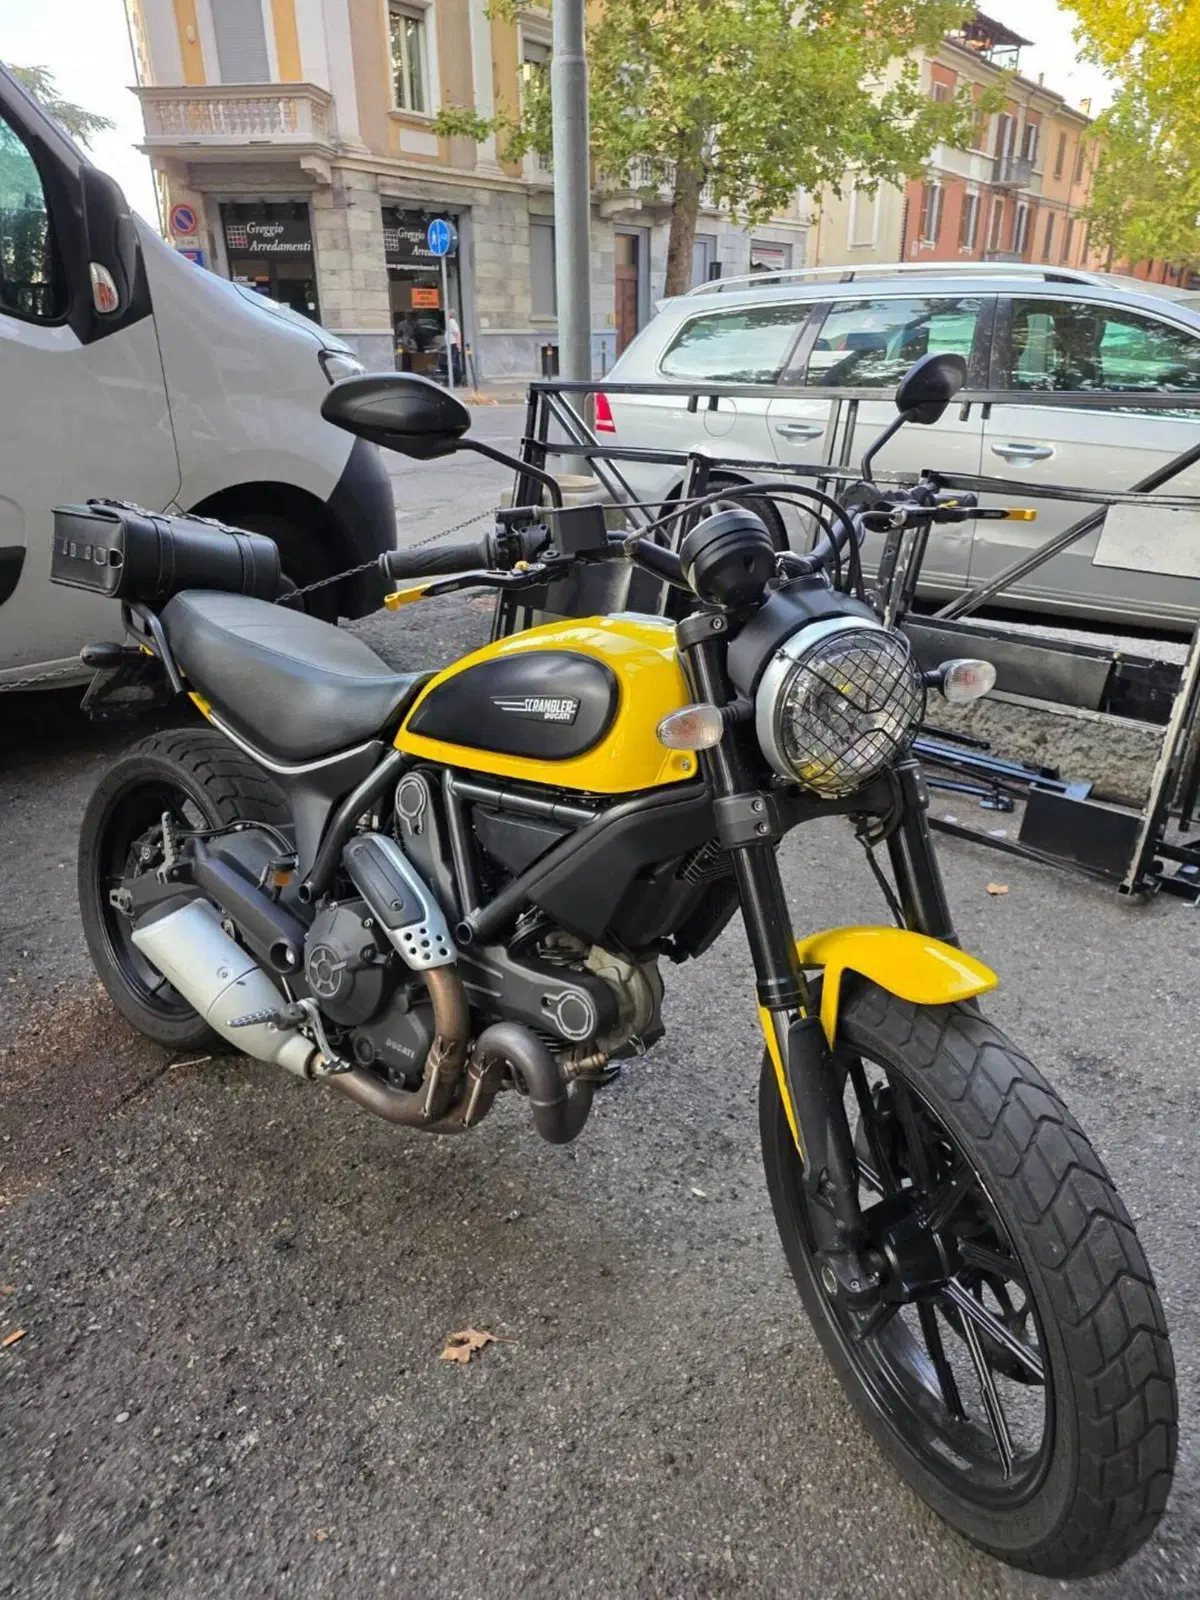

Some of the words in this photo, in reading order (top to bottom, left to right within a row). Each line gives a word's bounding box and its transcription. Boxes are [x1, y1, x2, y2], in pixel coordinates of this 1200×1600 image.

[246, 221, 284, 237] Greggio
[249, 239, 312, 252] Arredamenti
[524, 698, 575, 714] SCRAMBLER
[543, 712, 571, 720] DUCATI
[385, 1038, 416, 1059] DUCATI
